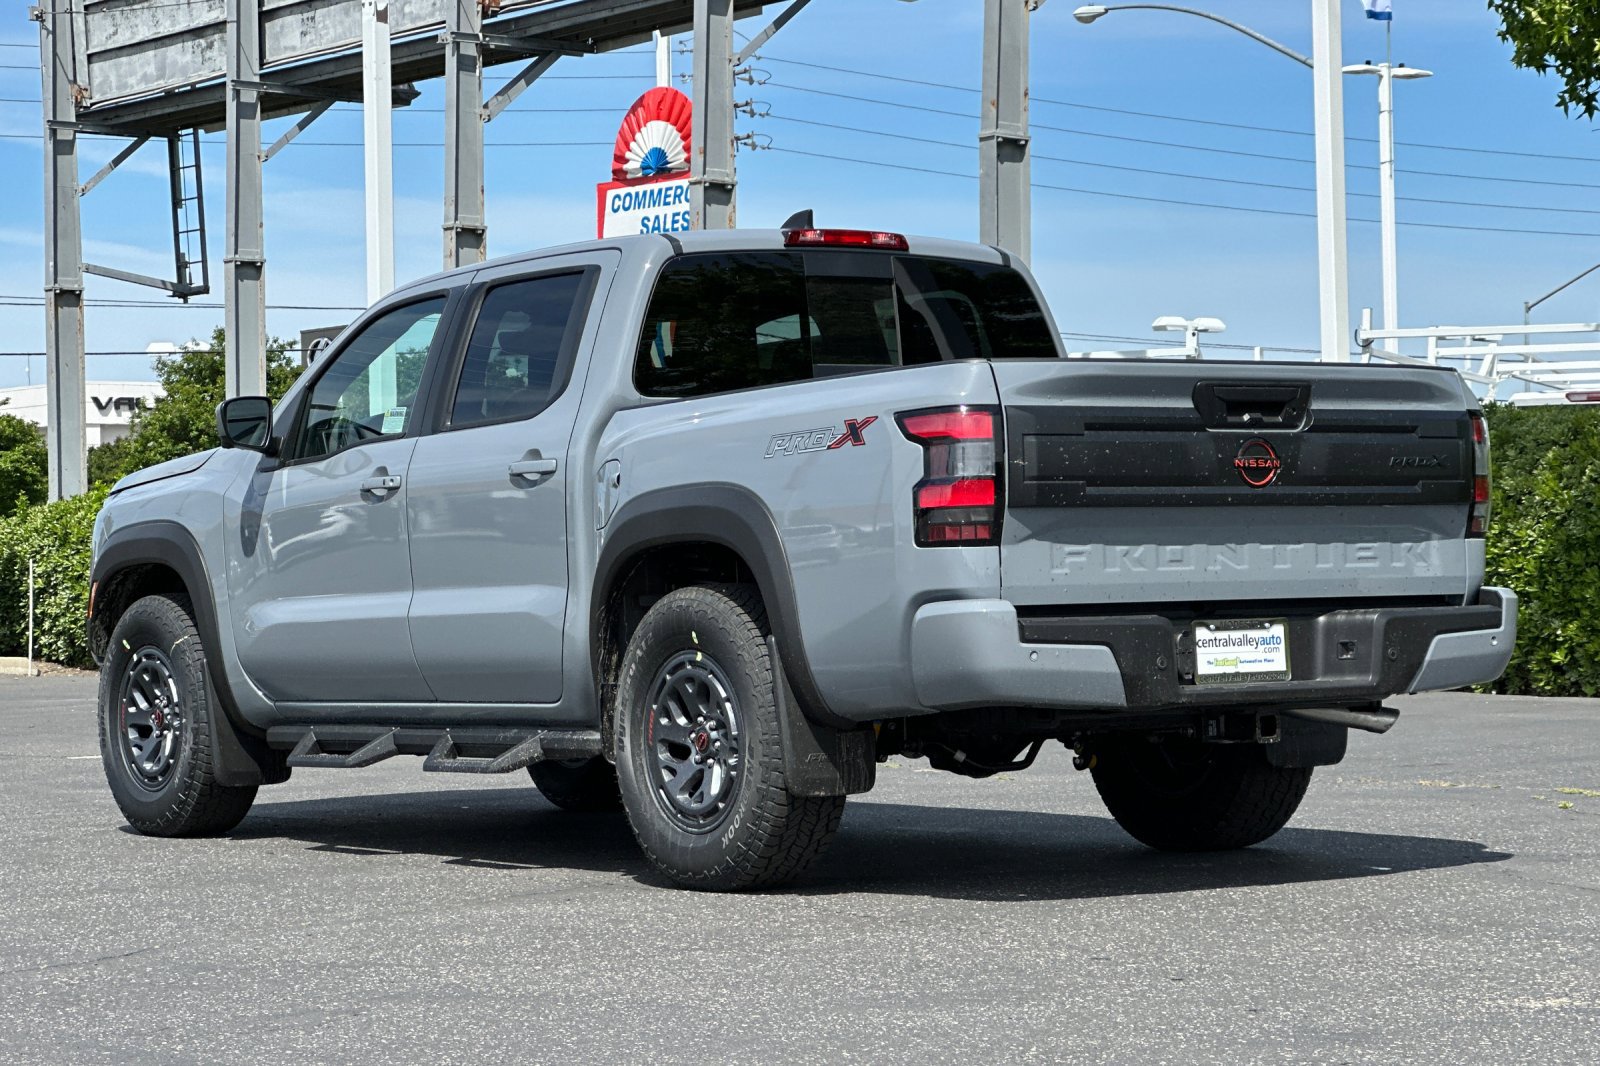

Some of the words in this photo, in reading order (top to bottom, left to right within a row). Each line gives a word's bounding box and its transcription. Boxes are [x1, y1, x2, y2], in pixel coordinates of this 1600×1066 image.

[640, 211, 690, 234] SALES
[1233, 459, 1281, 467] NISSAN
[1050, 541, 1439, 574] FRONTIER
[1196, 633, 1282, 649] centralvalleyauto
